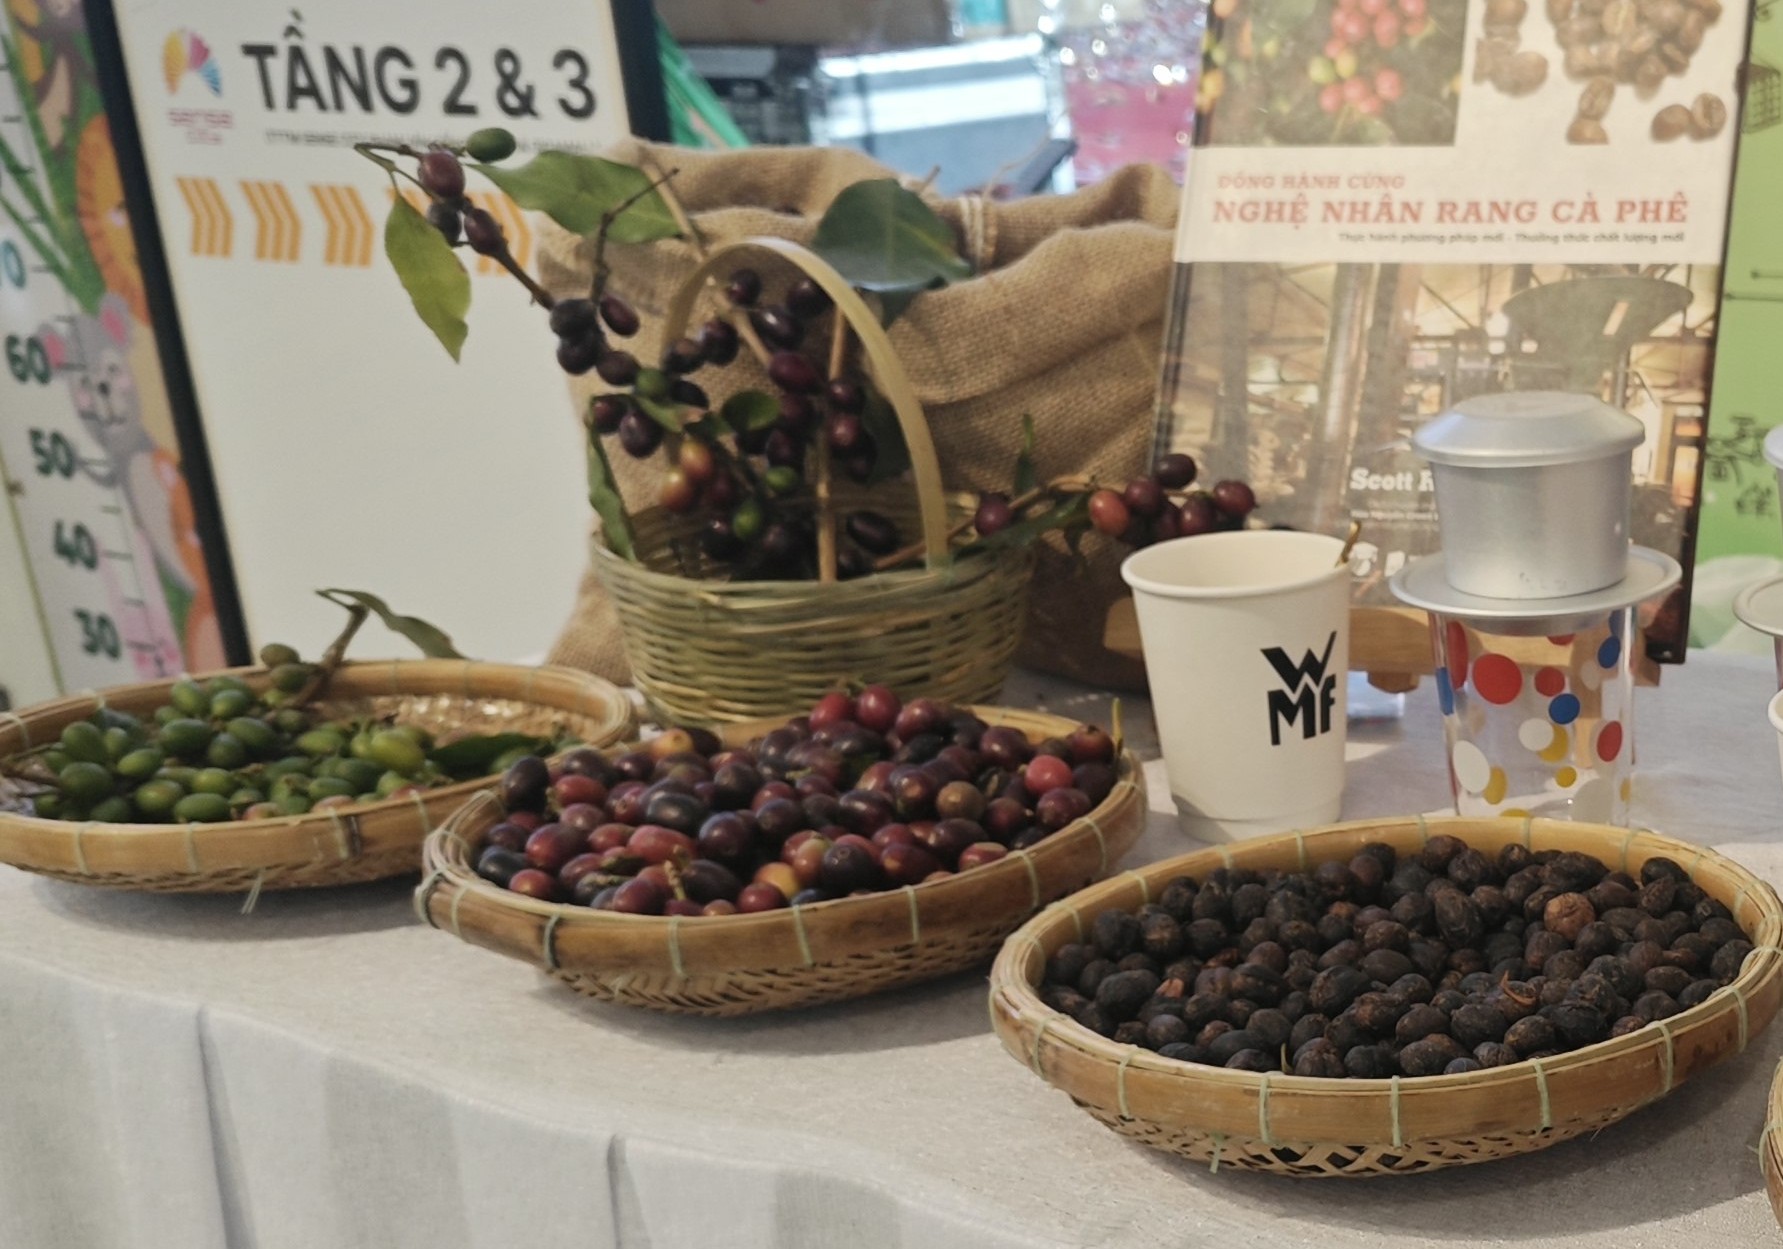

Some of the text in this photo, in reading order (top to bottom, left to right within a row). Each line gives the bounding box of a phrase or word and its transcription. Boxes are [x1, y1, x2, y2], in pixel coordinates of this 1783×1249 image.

[240, 8, 597, 120] TẦNG 2 & 3
[1212, 191, 1689, 231] NGHỆ NHÂN RANG CÀ PHÊ
[5, 334, 51, 386] 60
[30, 427, 76, 479] 50
[1350, 466, 1413, 492] Scott
[54, 519, 98, 571] 40
[73, 607, 121, 662] 30
